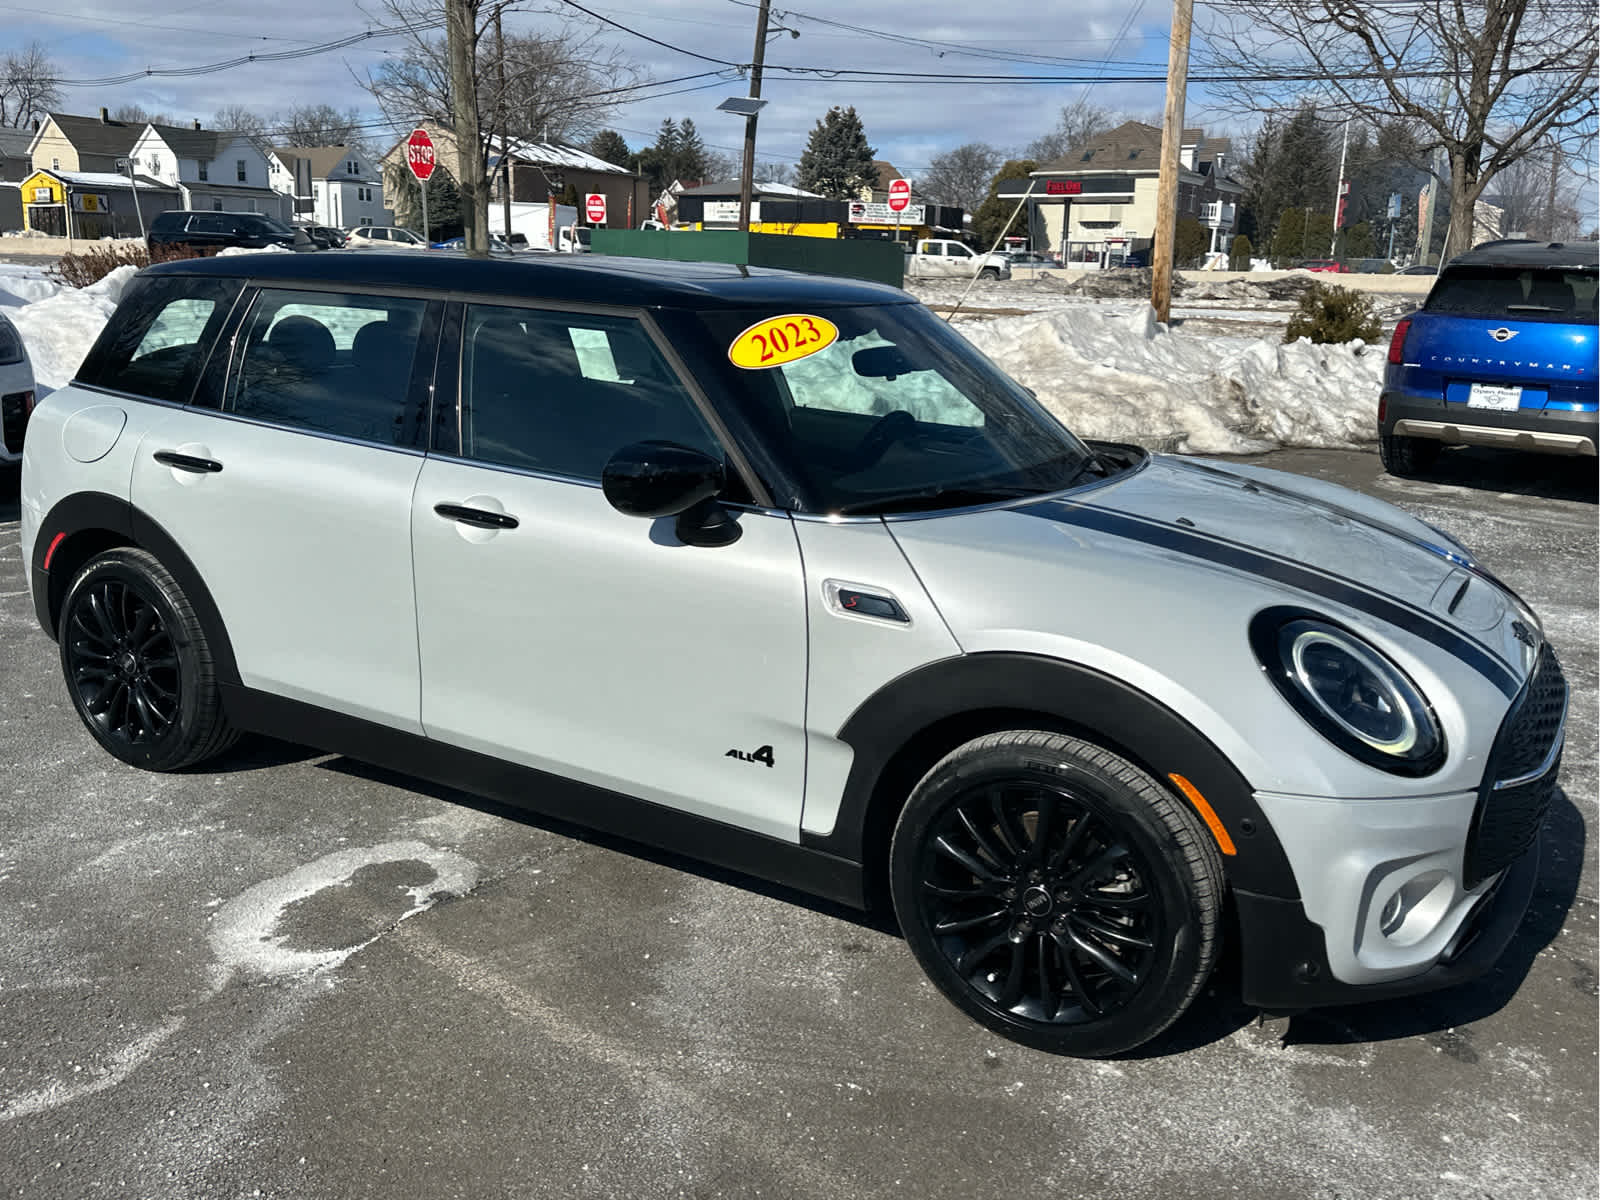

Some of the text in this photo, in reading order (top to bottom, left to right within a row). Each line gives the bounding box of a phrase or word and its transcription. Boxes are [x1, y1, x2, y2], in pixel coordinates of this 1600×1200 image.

[409, 144, 433, 164] STOP
[751, 318, 821, 362] 2023
[1431, 355, 1571, 370] COUNTRYMAN
[844, 595, 861, 608] S
[724, 745, 775, 768] ALL4
